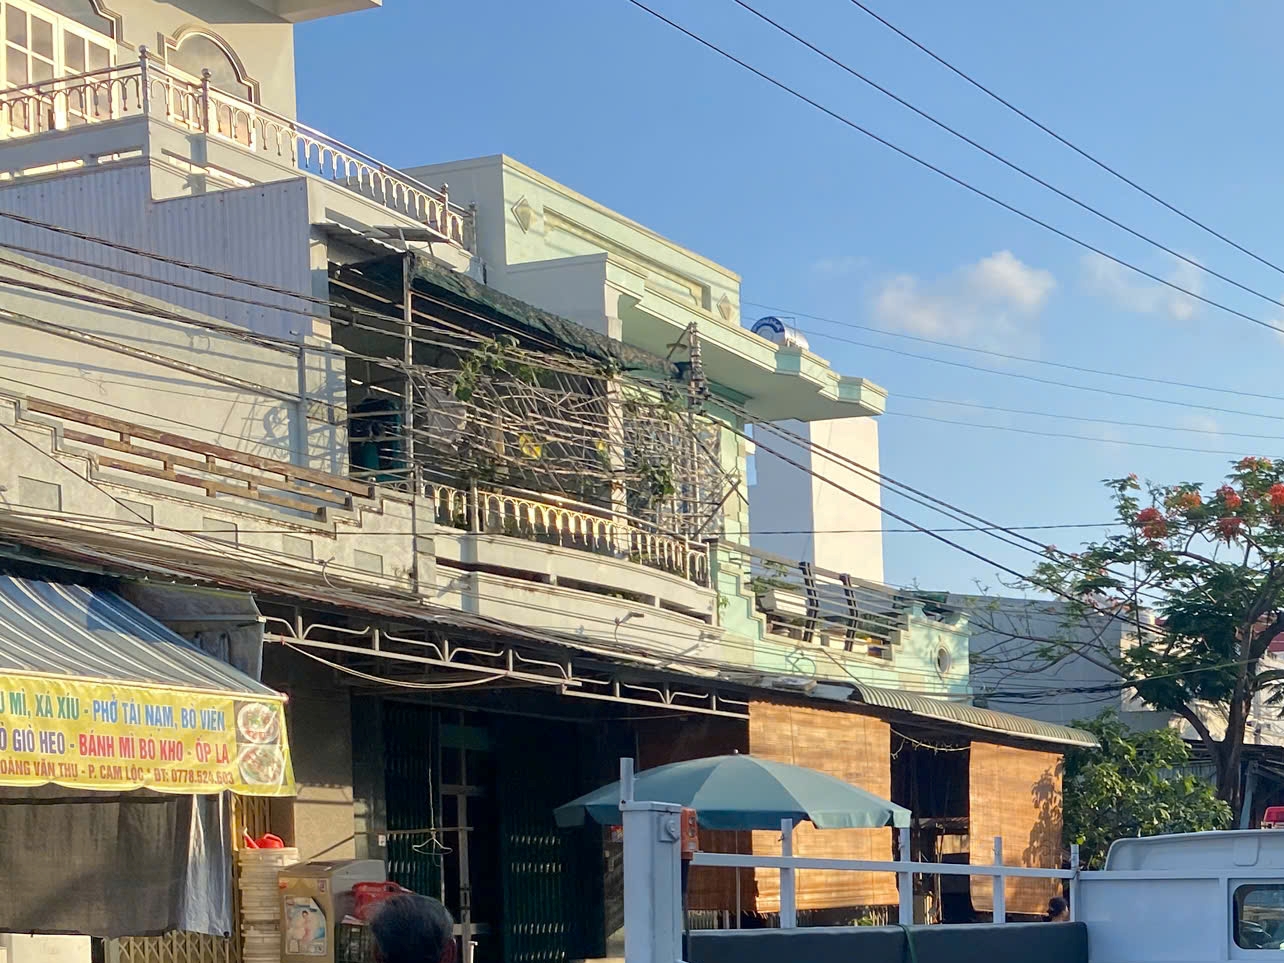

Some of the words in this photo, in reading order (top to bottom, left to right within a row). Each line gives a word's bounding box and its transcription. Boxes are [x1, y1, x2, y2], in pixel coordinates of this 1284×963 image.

[13, 724, 35, 753] GIÒ
[39, 730, 66, 755] HEO
[79, 730, 115, 757] BÁNH
[160, 740, 184, 761] KHO
[215, 743, 230, 764] LA
[88, 765, 97, 779] P.
[100, 765, 123, 781] CAM
